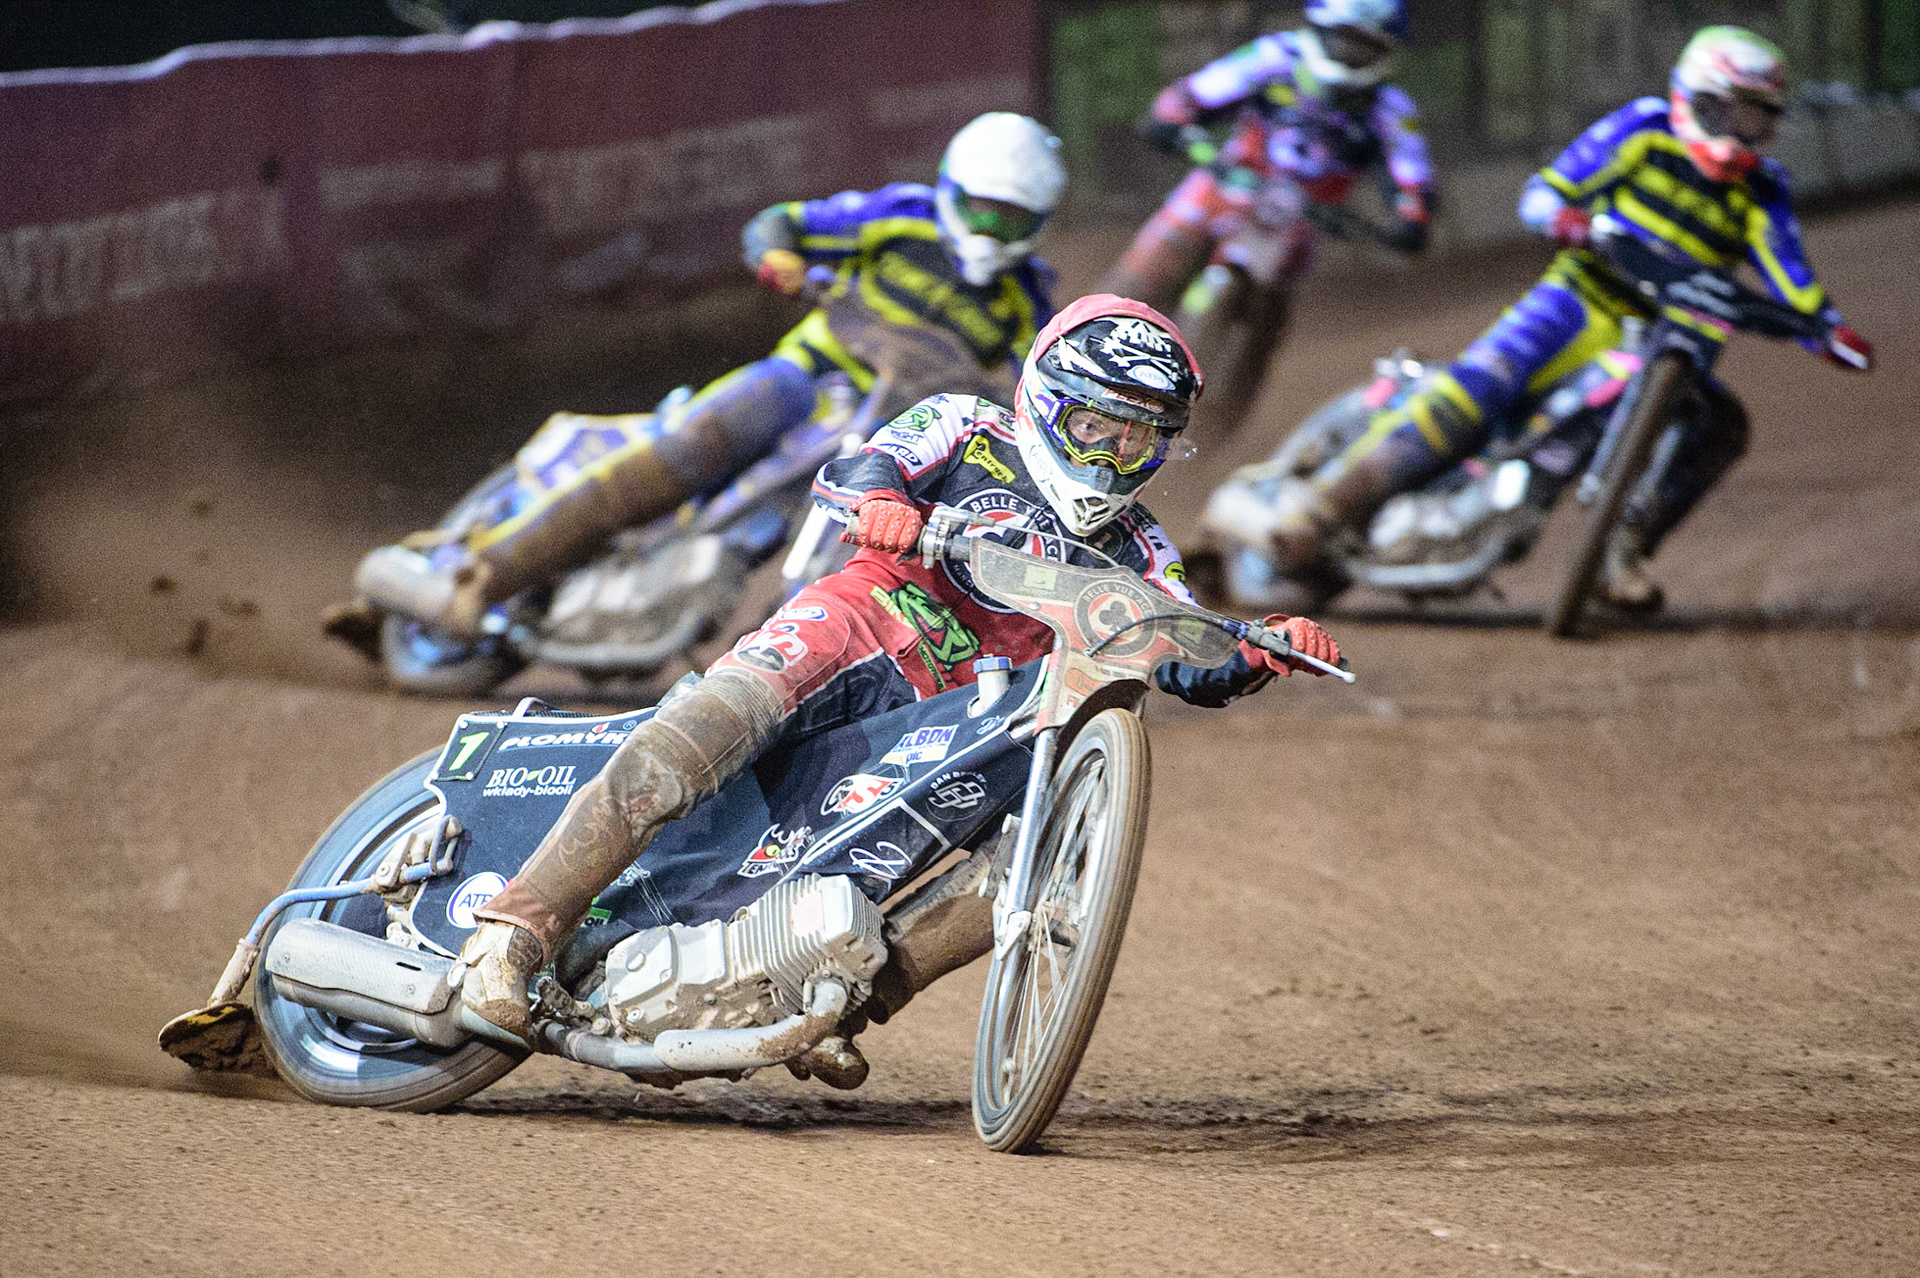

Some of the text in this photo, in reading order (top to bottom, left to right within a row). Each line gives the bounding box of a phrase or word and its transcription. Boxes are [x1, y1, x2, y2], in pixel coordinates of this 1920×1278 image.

[970, 496, 1019, 513] BELLE
[1025, 505, 1052, 531] VE
[1083, 583, 1111, 602] BELLE
[1114, 583, 1136, 599] VUE
[449, 731, 490, 771] 1
[486, 765, 577, 788] BIO OIL
[930, 772, 951, 790] DAN
